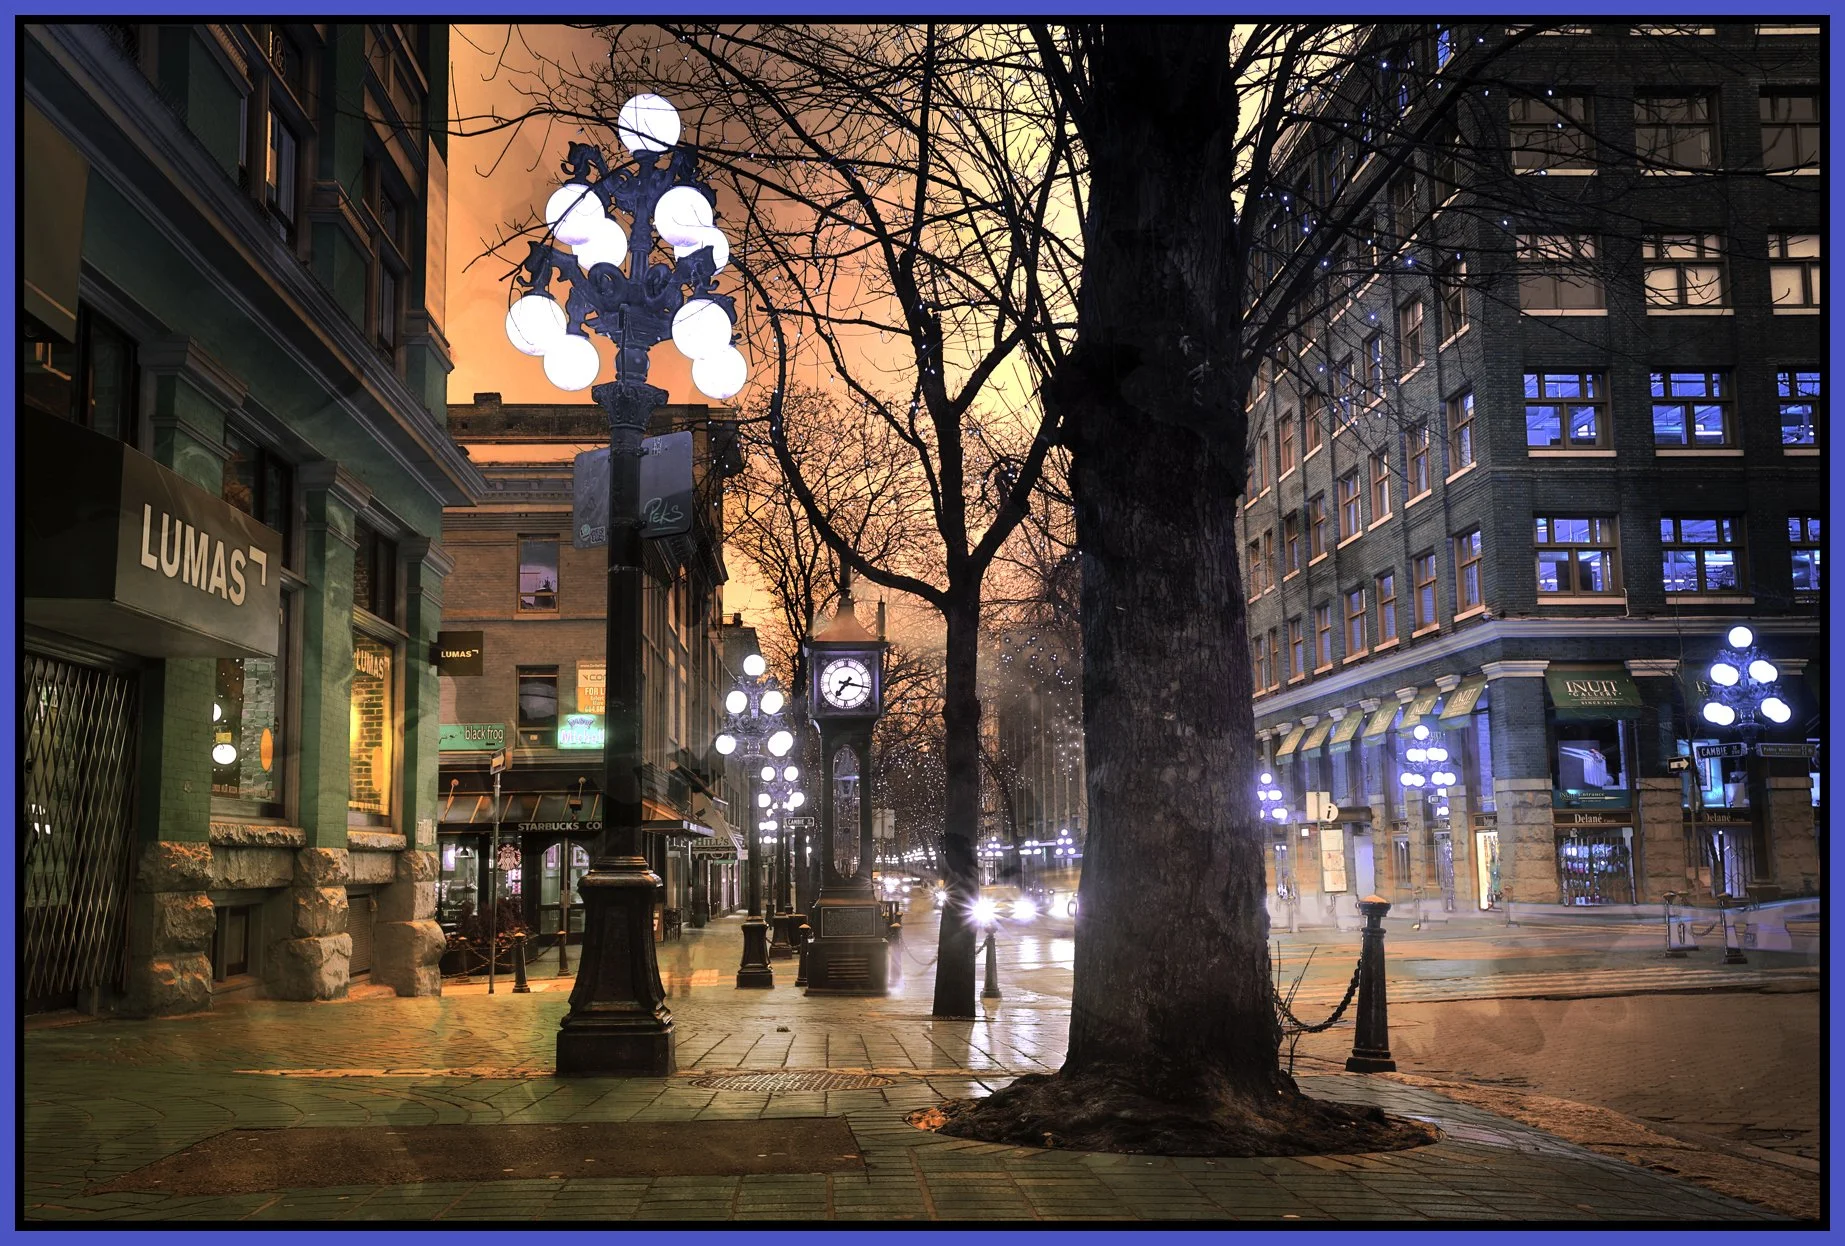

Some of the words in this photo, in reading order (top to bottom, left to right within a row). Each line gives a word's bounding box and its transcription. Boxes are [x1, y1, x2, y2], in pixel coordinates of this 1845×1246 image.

[141, 503, 247, 606] LUMAS
[441, 650, 472, 658] LUMAS
[356, 649, 384, 680] LUMAS
[585, 687, 599, 695] FOR
[1566, 680, 1618, 693] INUIT
[465, 726, 486, 740] black
[487, 726, 504, 743] frog
[1701, 746, 1728, 757] CAMBIE
[1574, 813, 1602, 823] Delané
[517, 822, 580, 831] STARBUCKS
[586, 821, 602, 830] CO
[696, 836, 729, 846] HILL'S
